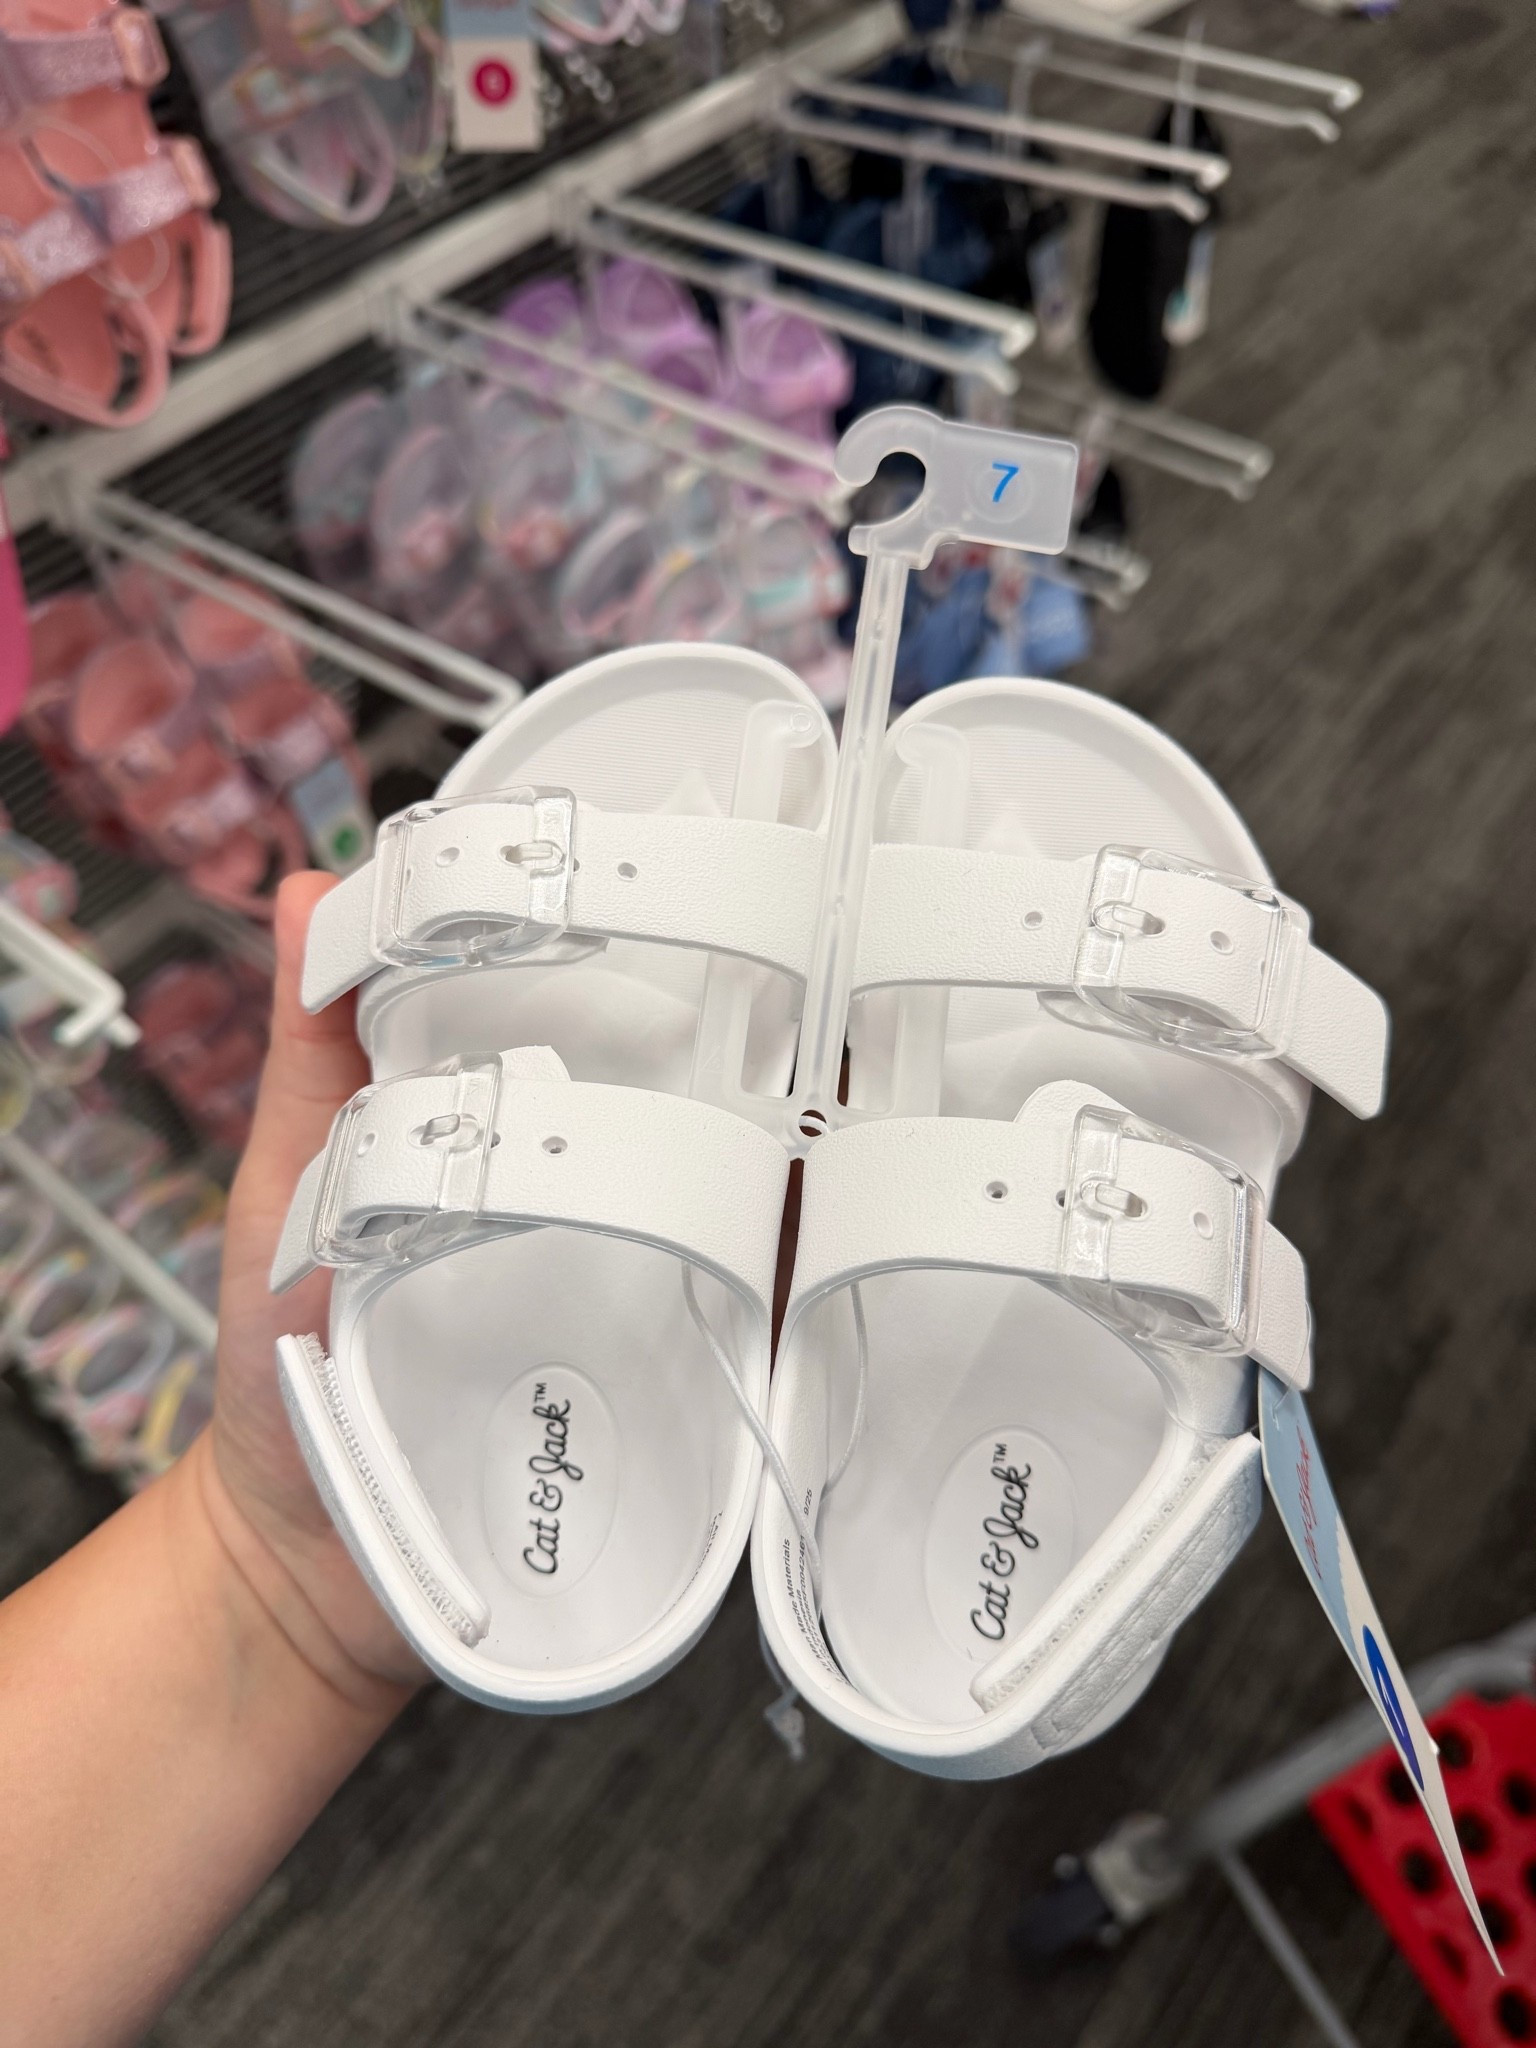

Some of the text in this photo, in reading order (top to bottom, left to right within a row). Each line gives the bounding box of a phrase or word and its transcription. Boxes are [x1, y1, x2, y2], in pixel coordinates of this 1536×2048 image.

[991, 462, 1019, 503] 7
[529, 1478, 563, 1512] &
[523, 1517, 560, 1575] Cat
[782, 1538, 795, 1597] Materials
[980, 1540, 1016, 1577] &
[970, 1580, 1011, 1641] Cat
